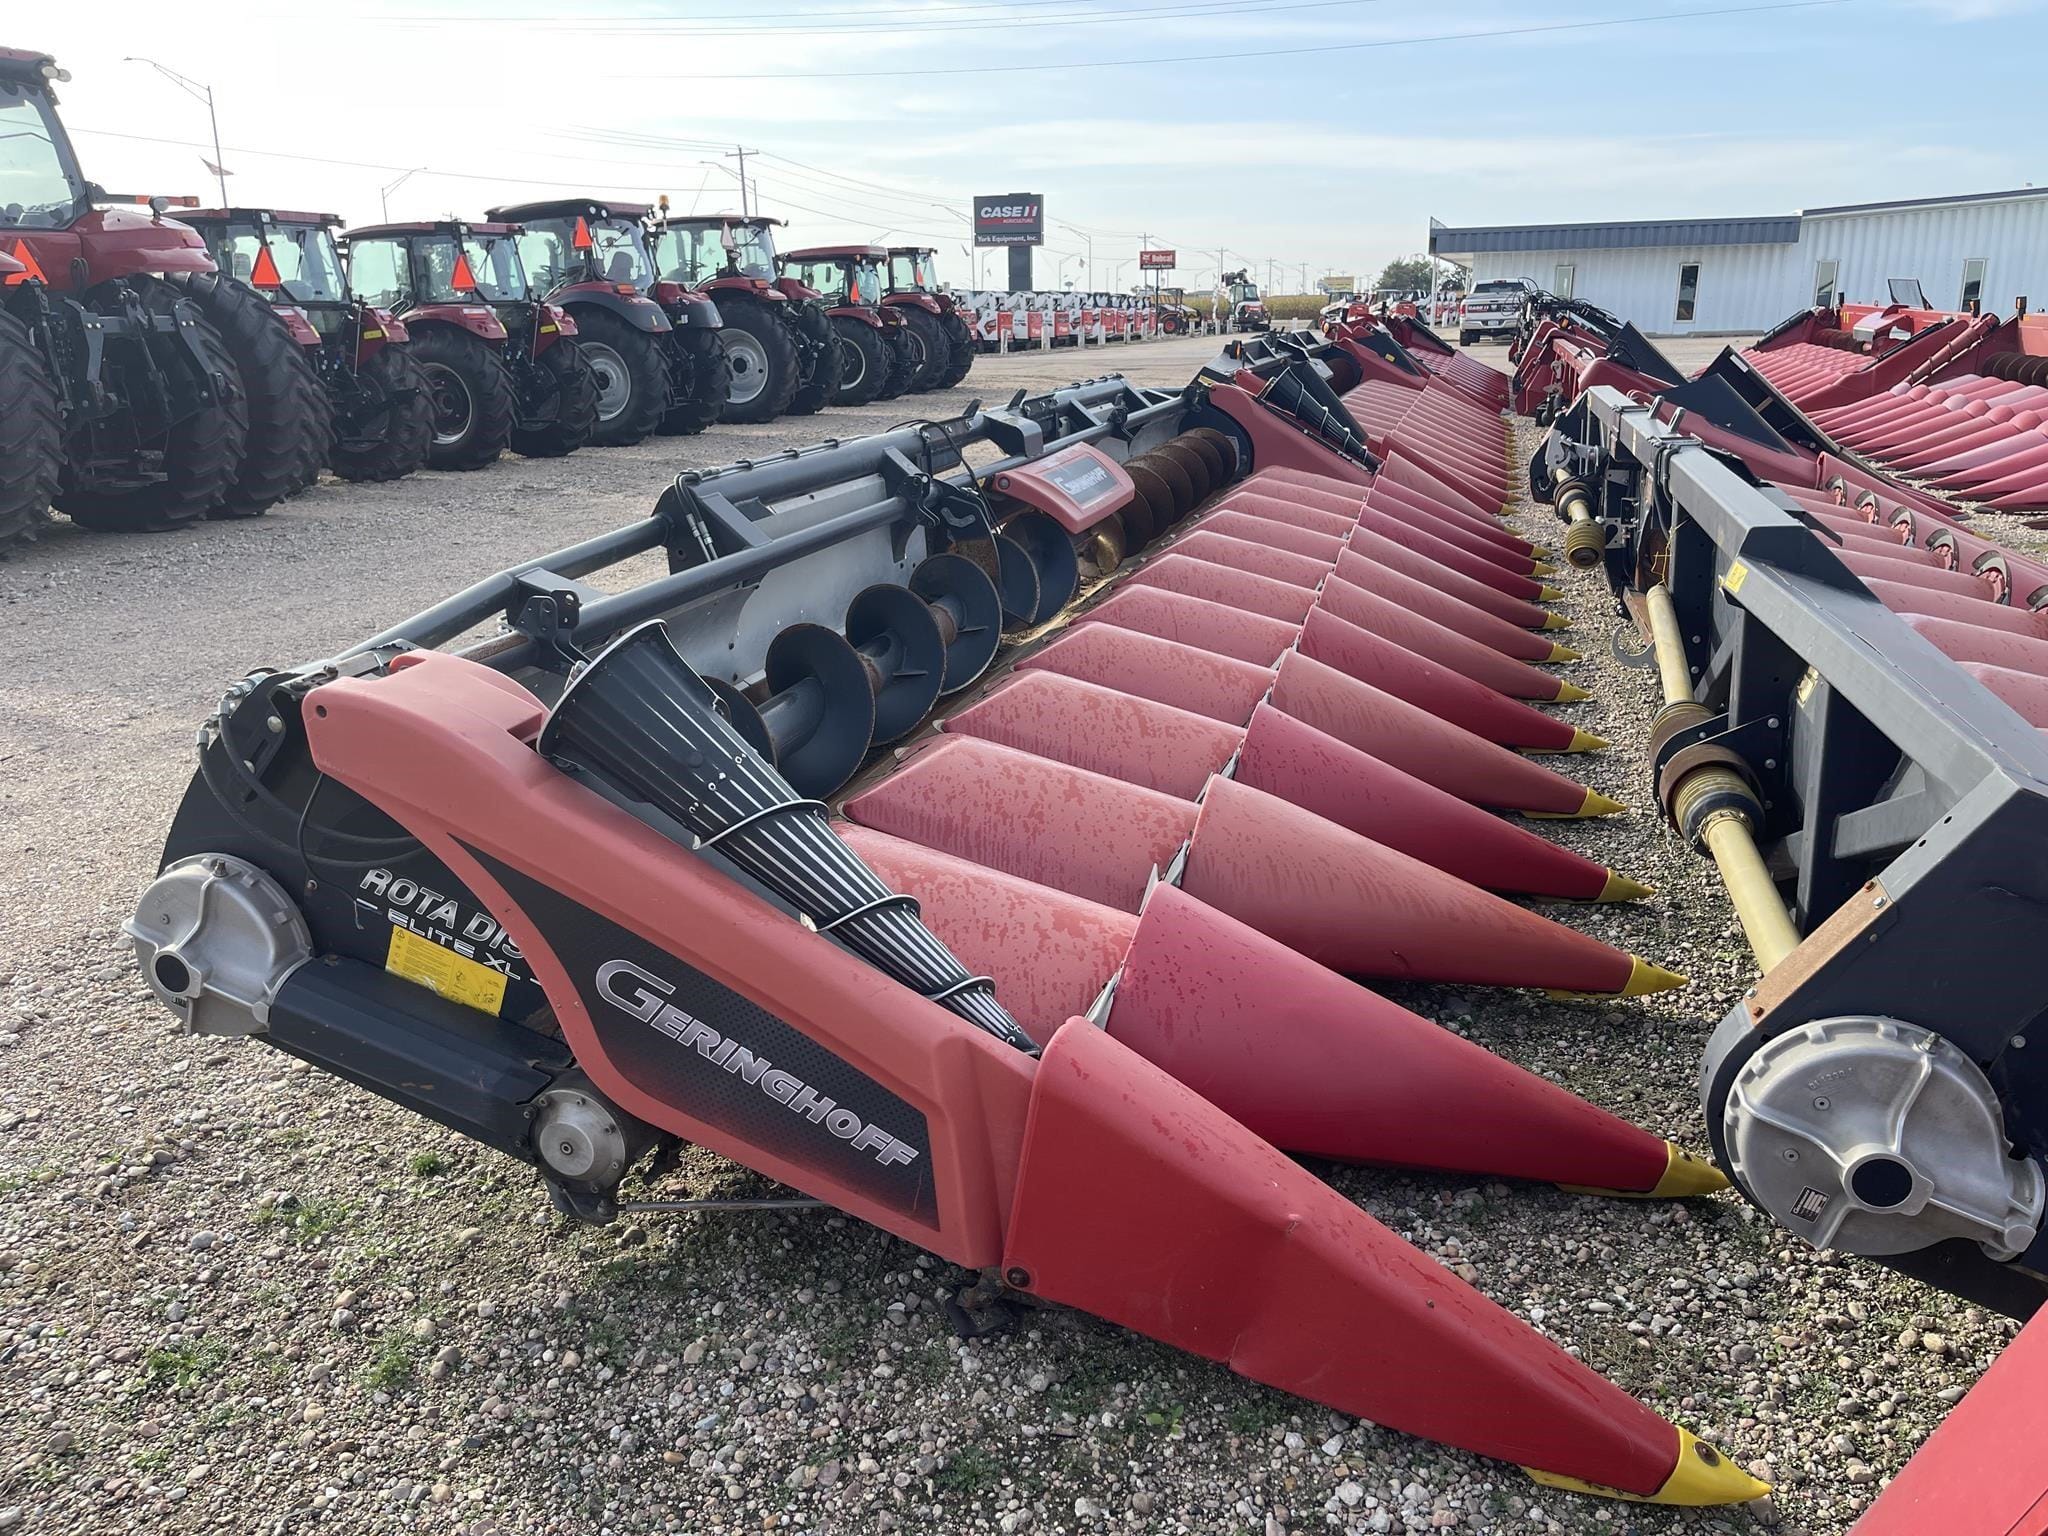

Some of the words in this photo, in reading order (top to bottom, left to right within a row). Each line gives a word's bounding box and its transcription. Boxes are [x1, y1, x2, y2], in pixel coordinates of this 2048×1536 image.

[977, 235, 992, 243] York
[992, 235, 1026, 244] Equipment,
[980, 206, 1023, 218] CASE
[360, 868, 459, 930] ROTA
[387, 908, 476, 958] ELITE
[483, 952, 521, 981] XL
[595, 959, 920, 1167] GERINGHOFF
